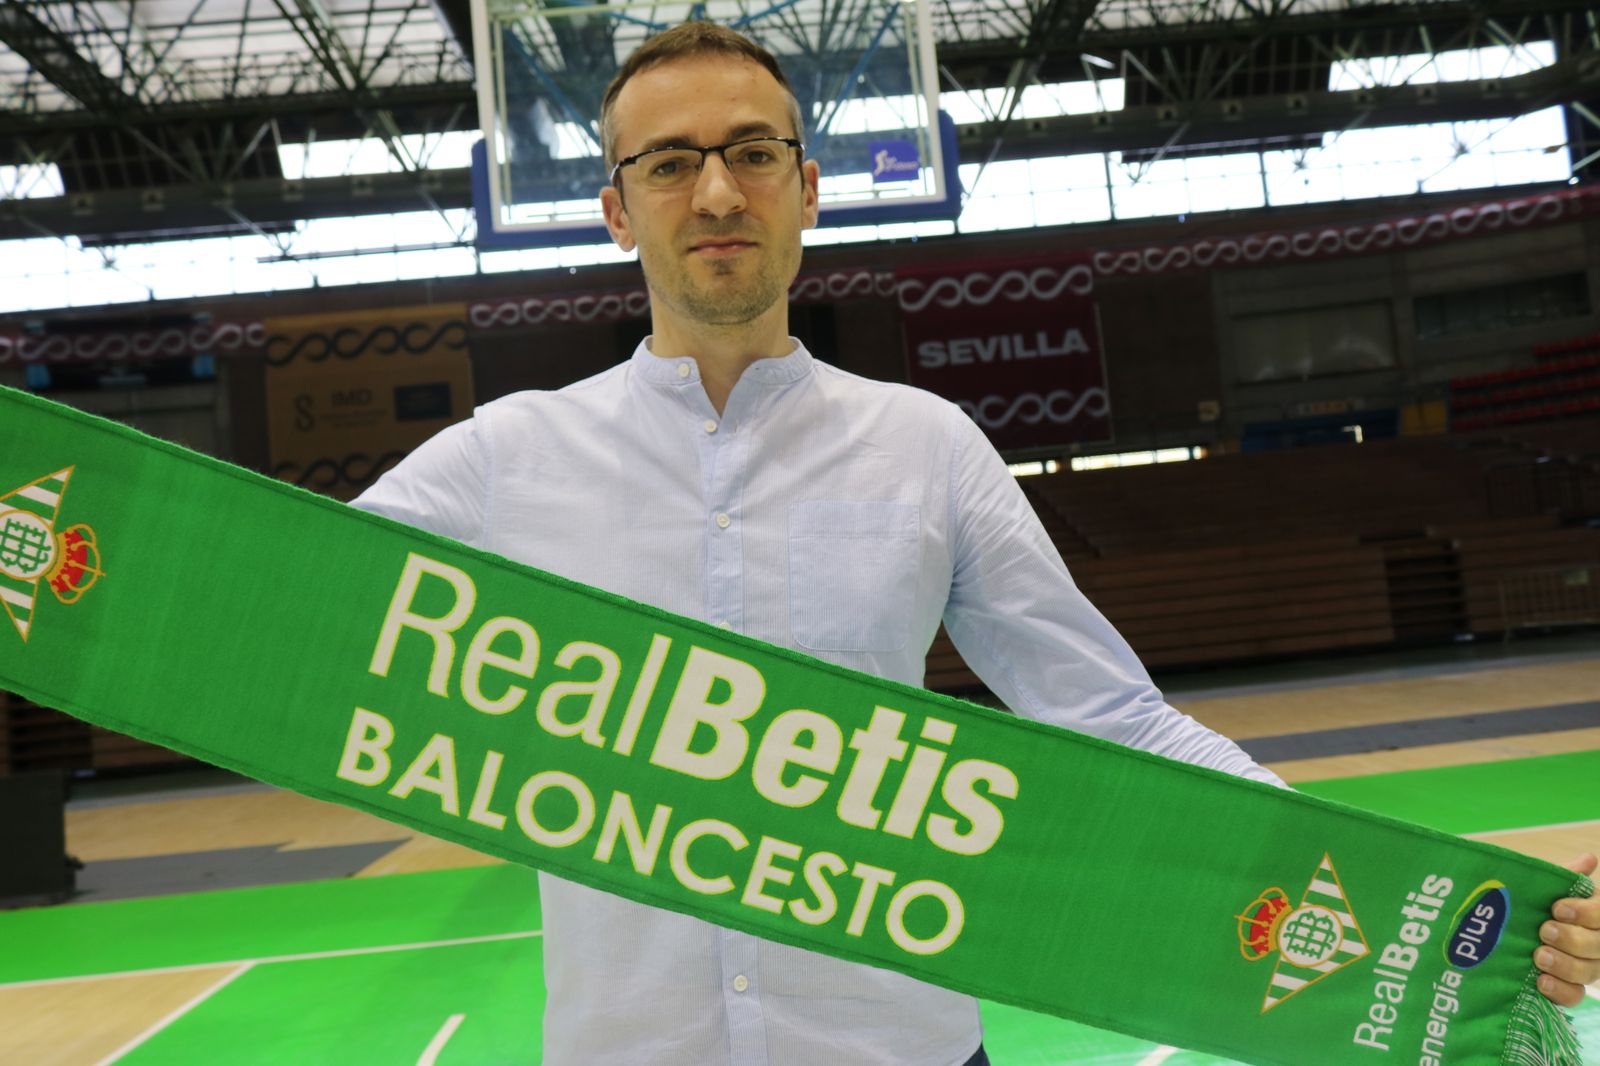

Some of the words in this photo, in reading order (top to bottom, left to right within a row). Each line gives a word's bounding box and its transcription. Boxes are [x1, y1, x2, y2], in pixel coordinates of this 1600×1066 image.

[918, 327, 1089, 368] SEVILLA
[335, 707, 965, 956] BALONCESTO
[1455, 903, 1494, 961] plus
